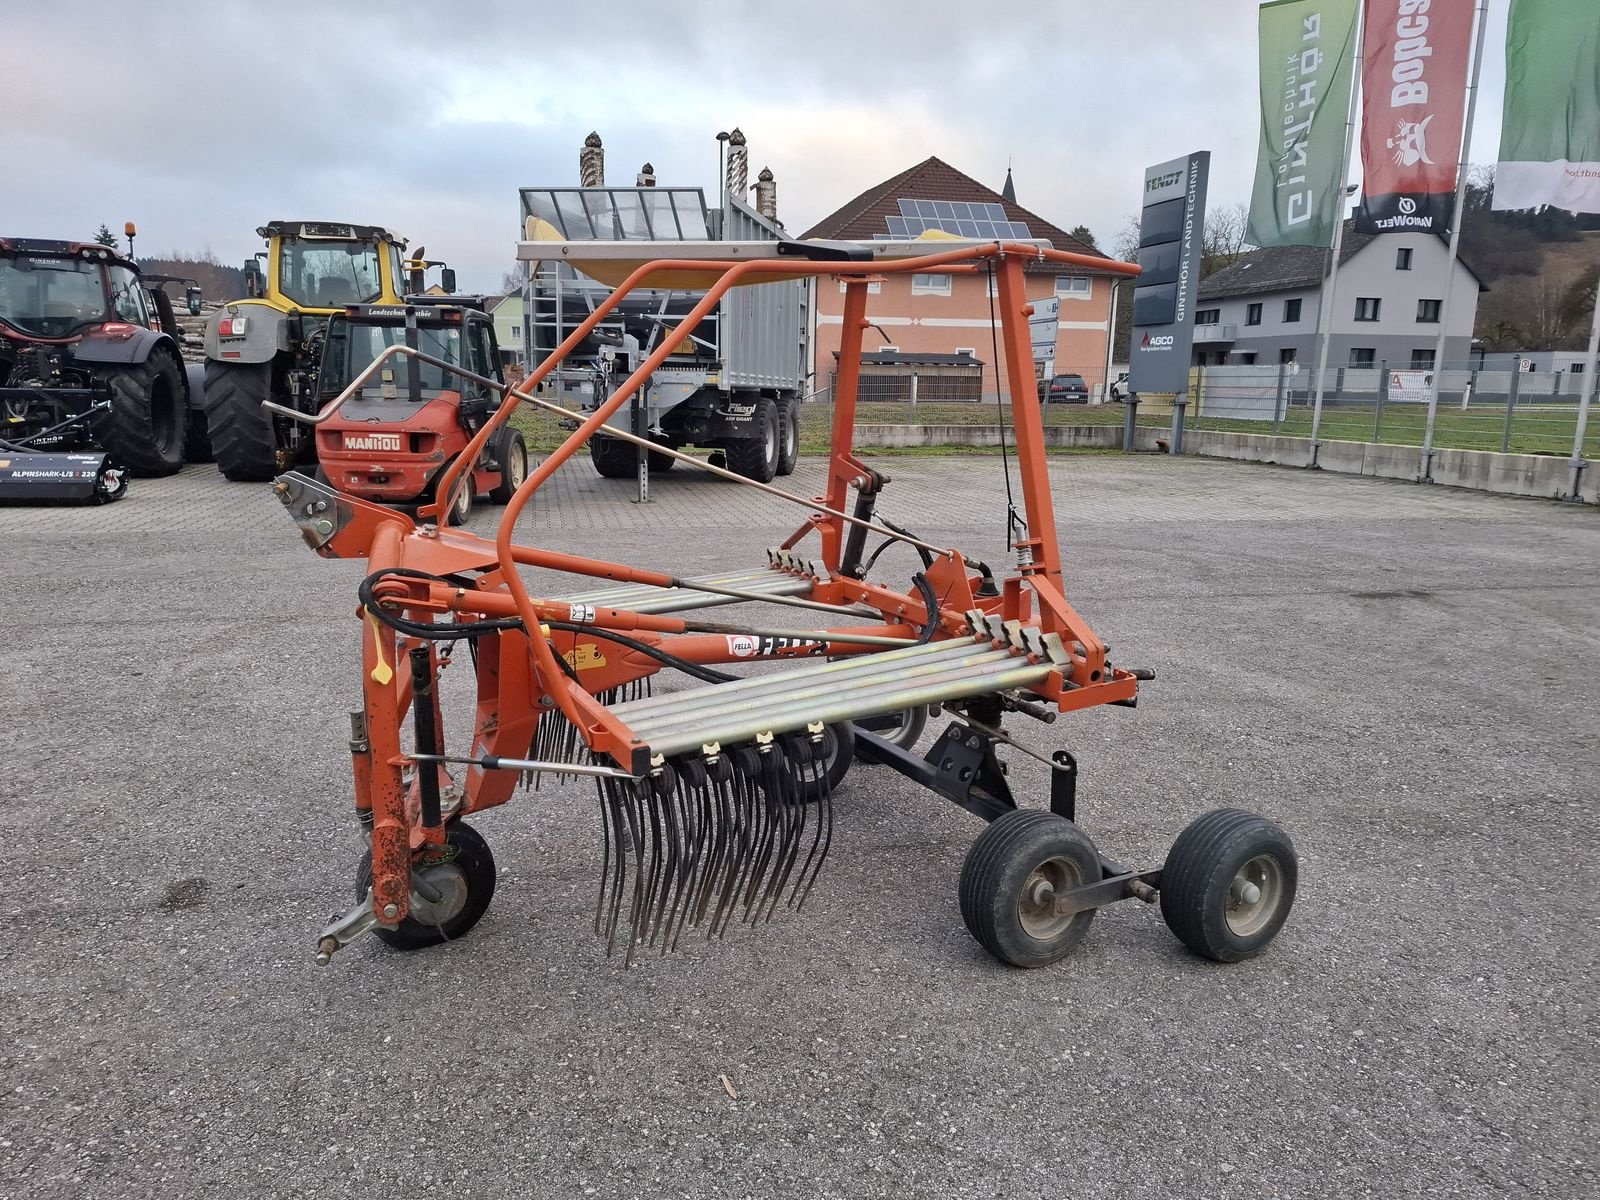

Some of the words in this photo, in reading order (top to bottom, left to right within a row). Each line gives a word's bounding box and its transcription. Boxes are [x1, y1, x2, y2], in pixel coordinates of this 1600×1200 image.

[1146, 170, 1184, 192] FENDT
[1184, 160, 1199, 257] LANDTECHNIK
[368, 308, 406, 316] Landtechnik
[1150, 336, 1174, 345] AGCO
[728, 403, 757, 416] Fliegl
[29, 435, 63, 445] INTHÖR
[734, 642, 752, 650] FELLA
